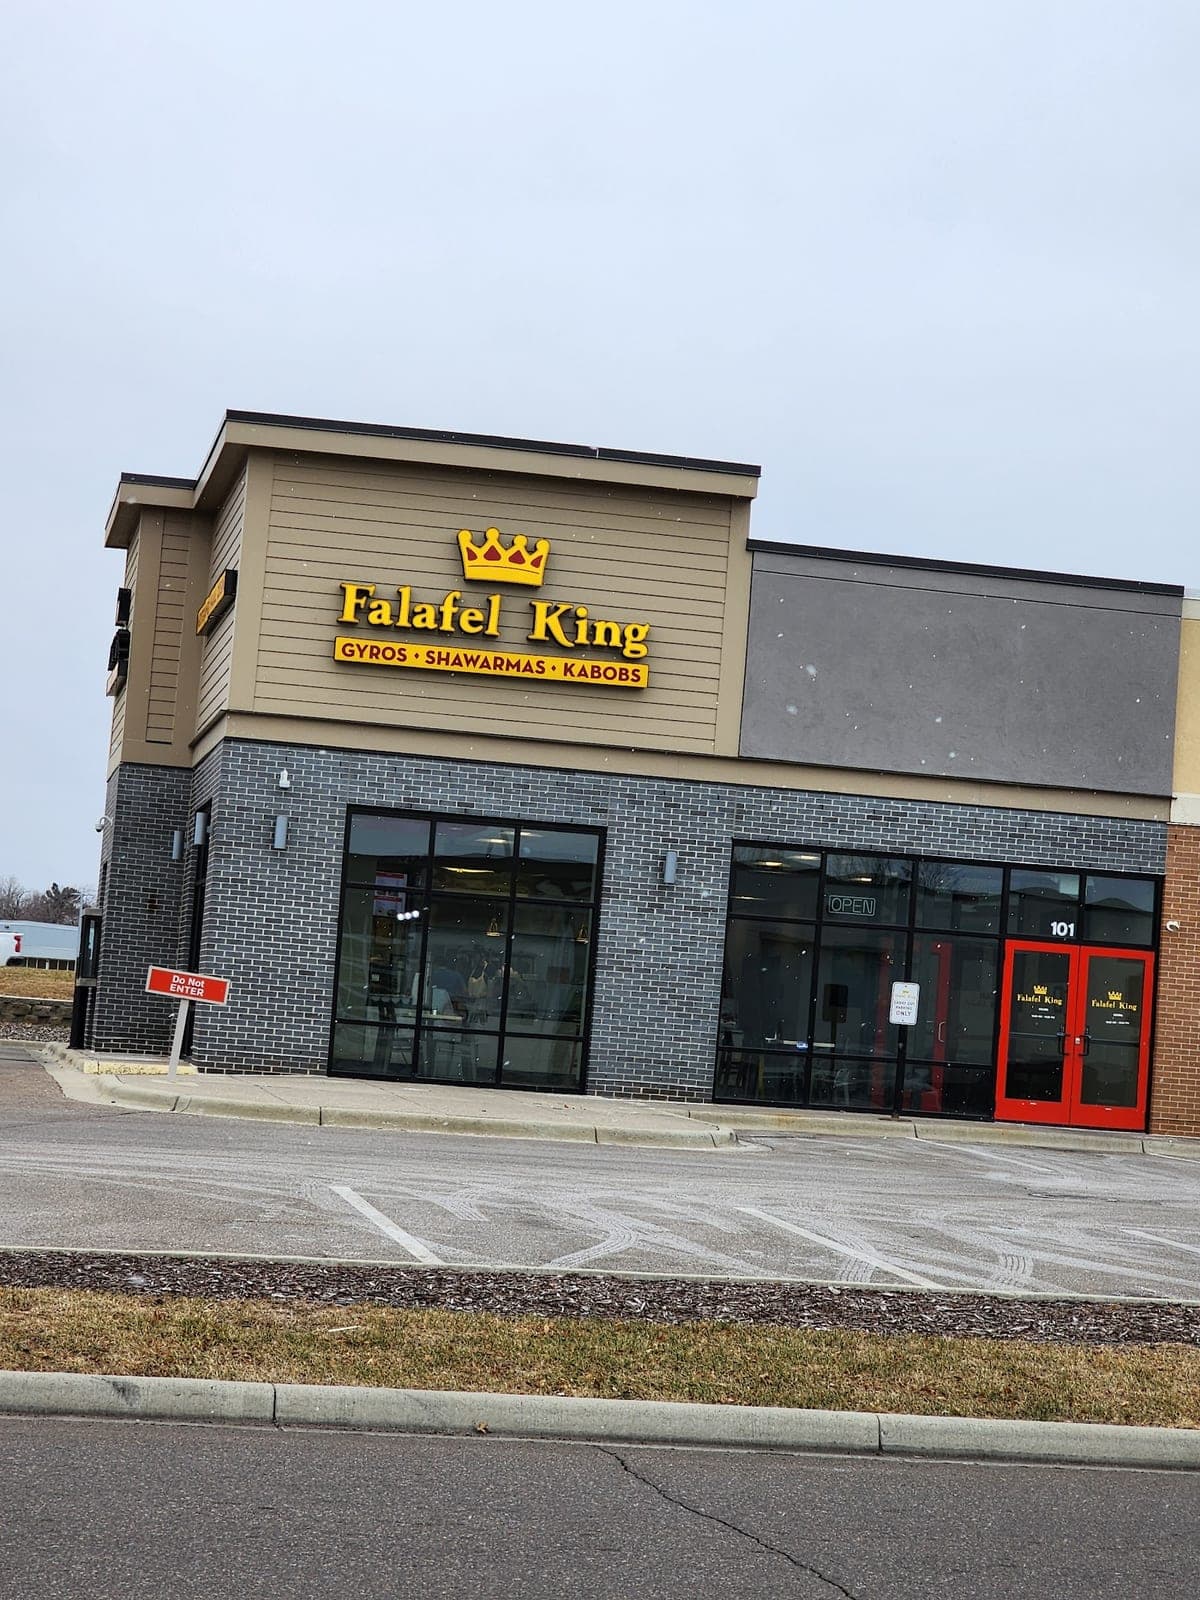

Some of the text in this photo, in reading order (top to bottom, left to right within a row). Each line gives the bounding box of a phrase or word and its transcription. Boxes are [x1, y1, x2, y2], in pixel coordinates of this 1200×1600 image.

[337, 582, 651, 660] Falafel King
[341, 643, 641, 683] GYROS SHAWARMAS KABOBS
[831, 897, 873, 914] OPEN
[1050, 921, 1075, 937] 101
[172, 975, 205, 988] Do Not
[170, 984, 204, 997] ENTER
[1017, 994, 1063, 1006] Falafel King
[1091, 999, 1137, 1011] Falafel King
